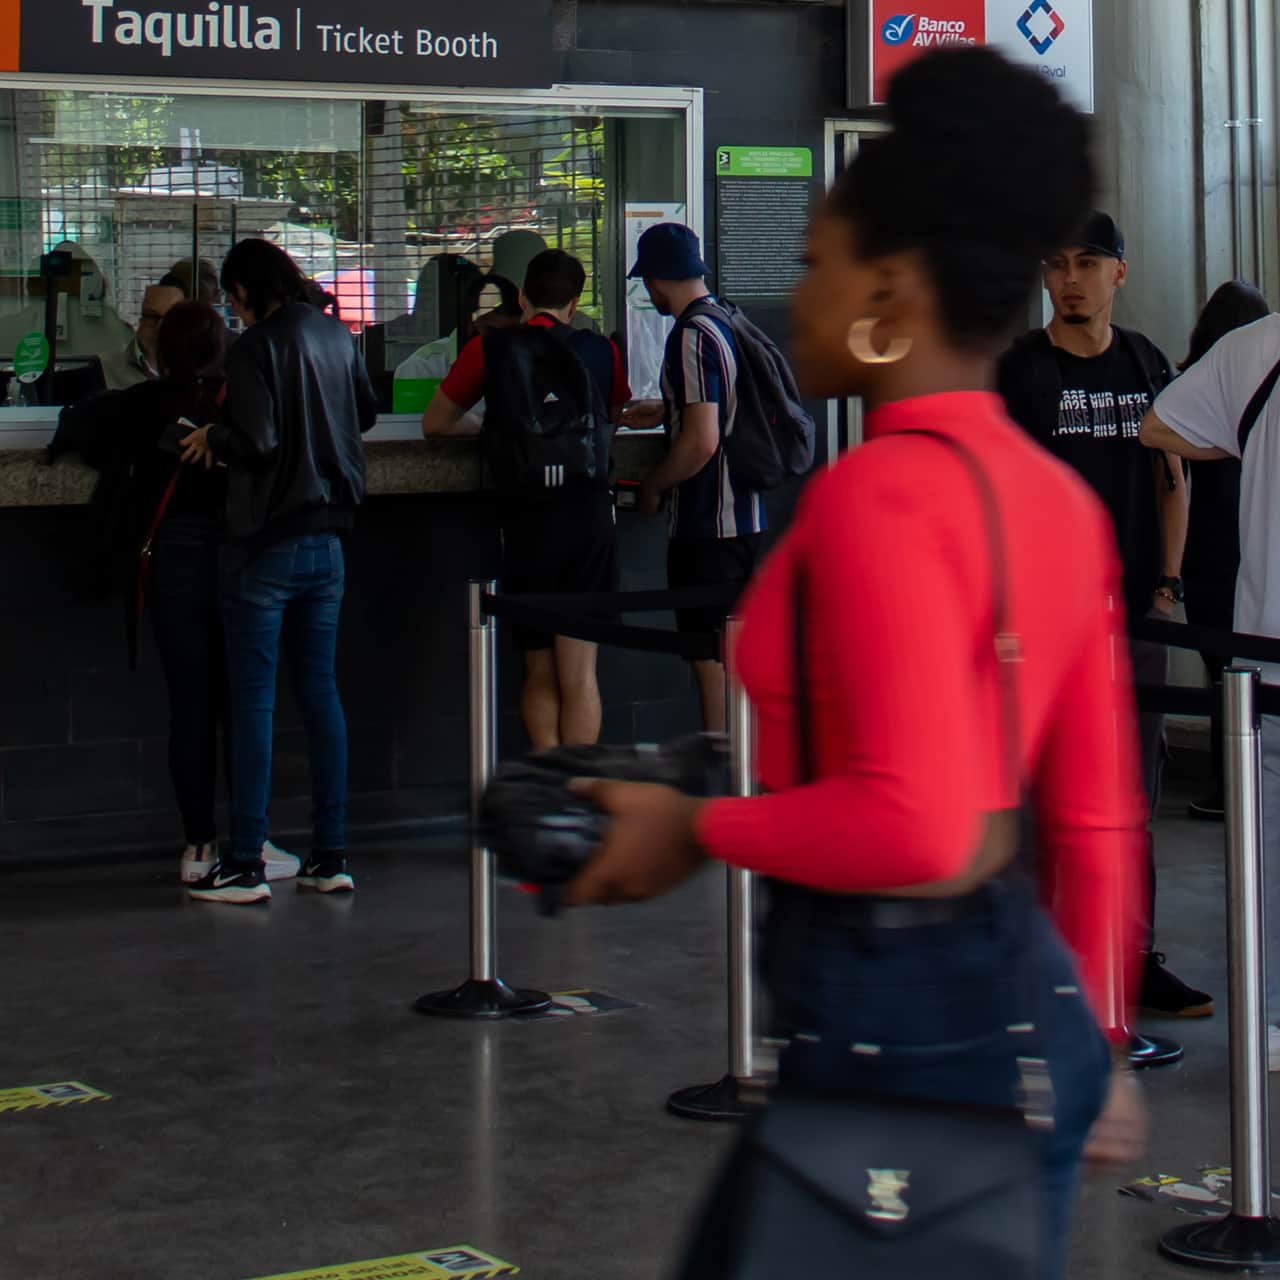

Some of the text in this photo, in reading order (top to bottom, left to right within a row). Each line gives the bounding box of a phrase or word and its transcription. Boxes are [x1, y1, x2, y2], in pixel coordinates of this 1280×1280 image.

[918, 16, 965, 33] Banco
[316, 24, 404, 55] Ticket
[415, 29, 498, 59] Booth
[912, 32, 931, 47] AV
